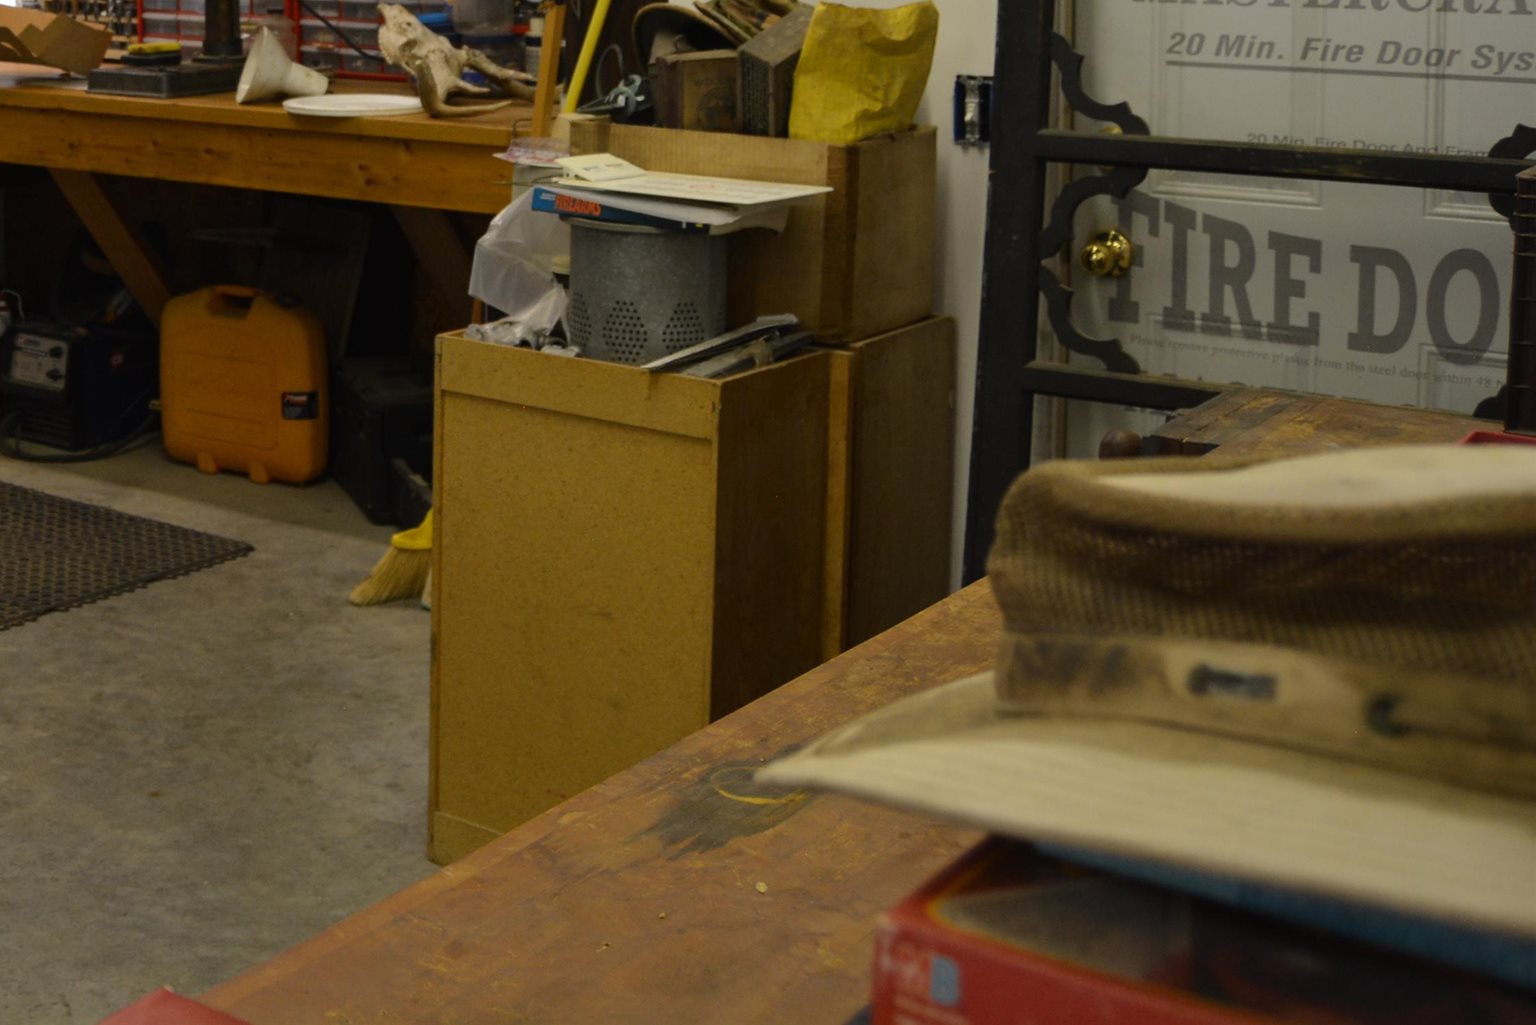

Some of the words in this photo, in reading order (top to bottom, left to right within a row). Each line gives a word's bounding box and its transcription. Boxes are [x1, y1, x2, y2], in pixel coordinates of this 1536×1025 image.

[1166, 31, 1205, 56] 20
[1214, 33, 1284, 60] Min.
[1300, 37, 1364, 64] Fire
[1376, 40, 1460, 68] Door
[554, 193, 603, 217] FIREARMS
[1107, 191, 1323, 347] FIRE
[1345, 359, 1365, 372] the
[1368, 364, 1397, 377] steel
